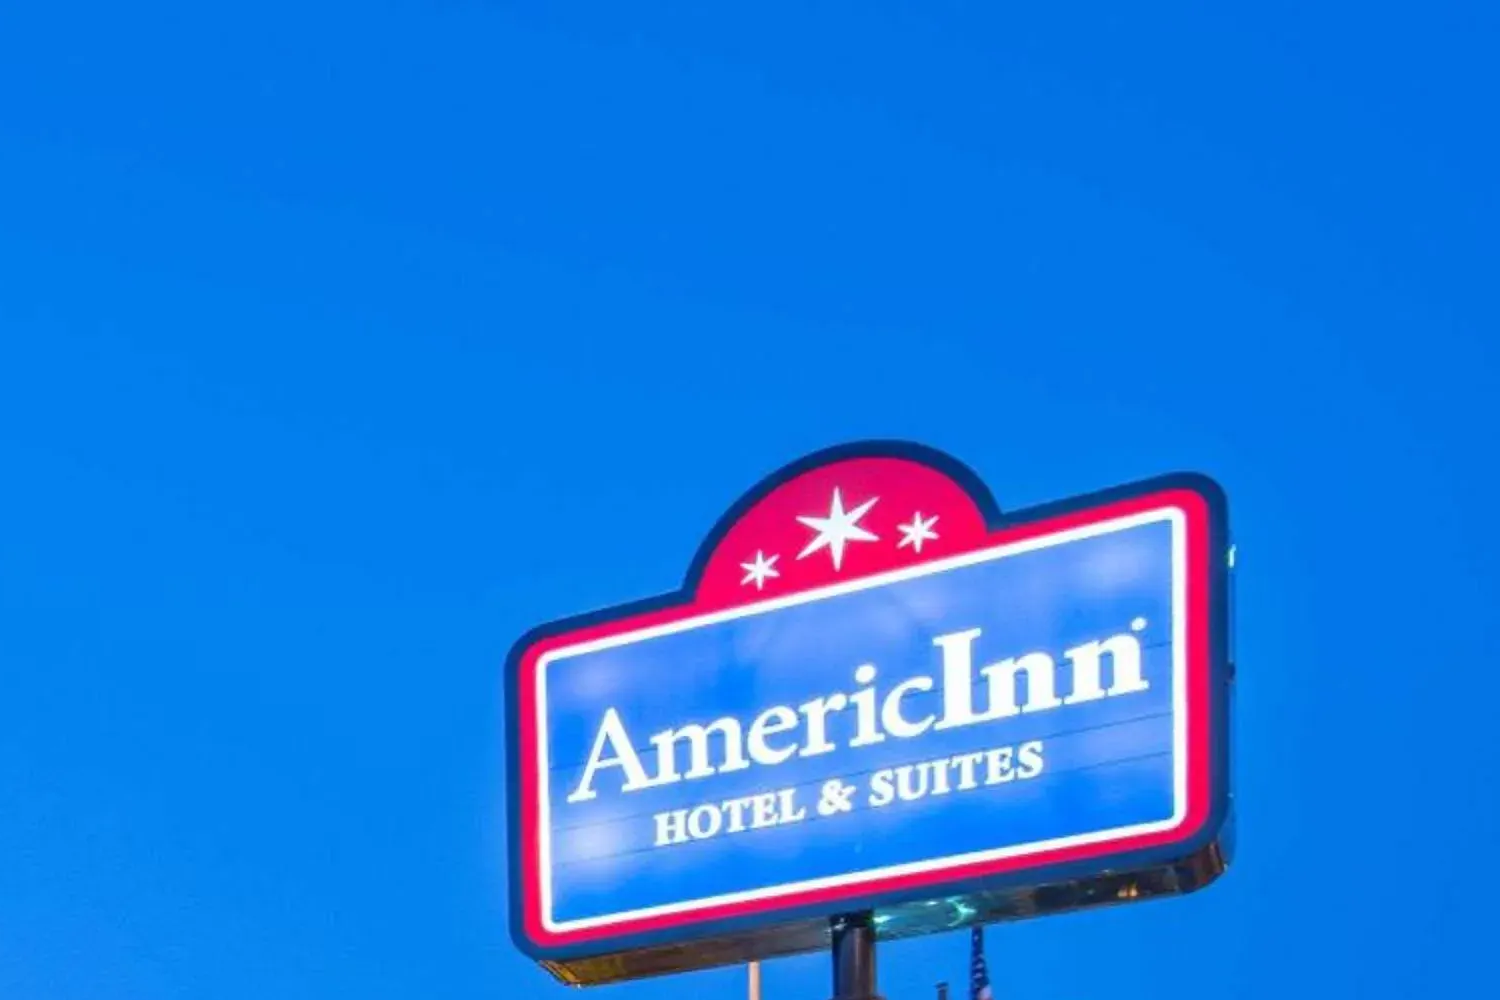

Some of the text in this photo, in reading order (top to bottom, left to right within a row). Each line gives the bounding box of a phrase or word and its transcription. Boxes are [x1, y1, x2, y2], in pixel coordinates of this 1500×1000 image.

[567, 617, 1149, 804] AmericInn
[653, 740, 1045, 847] HOTEL & SUITES
